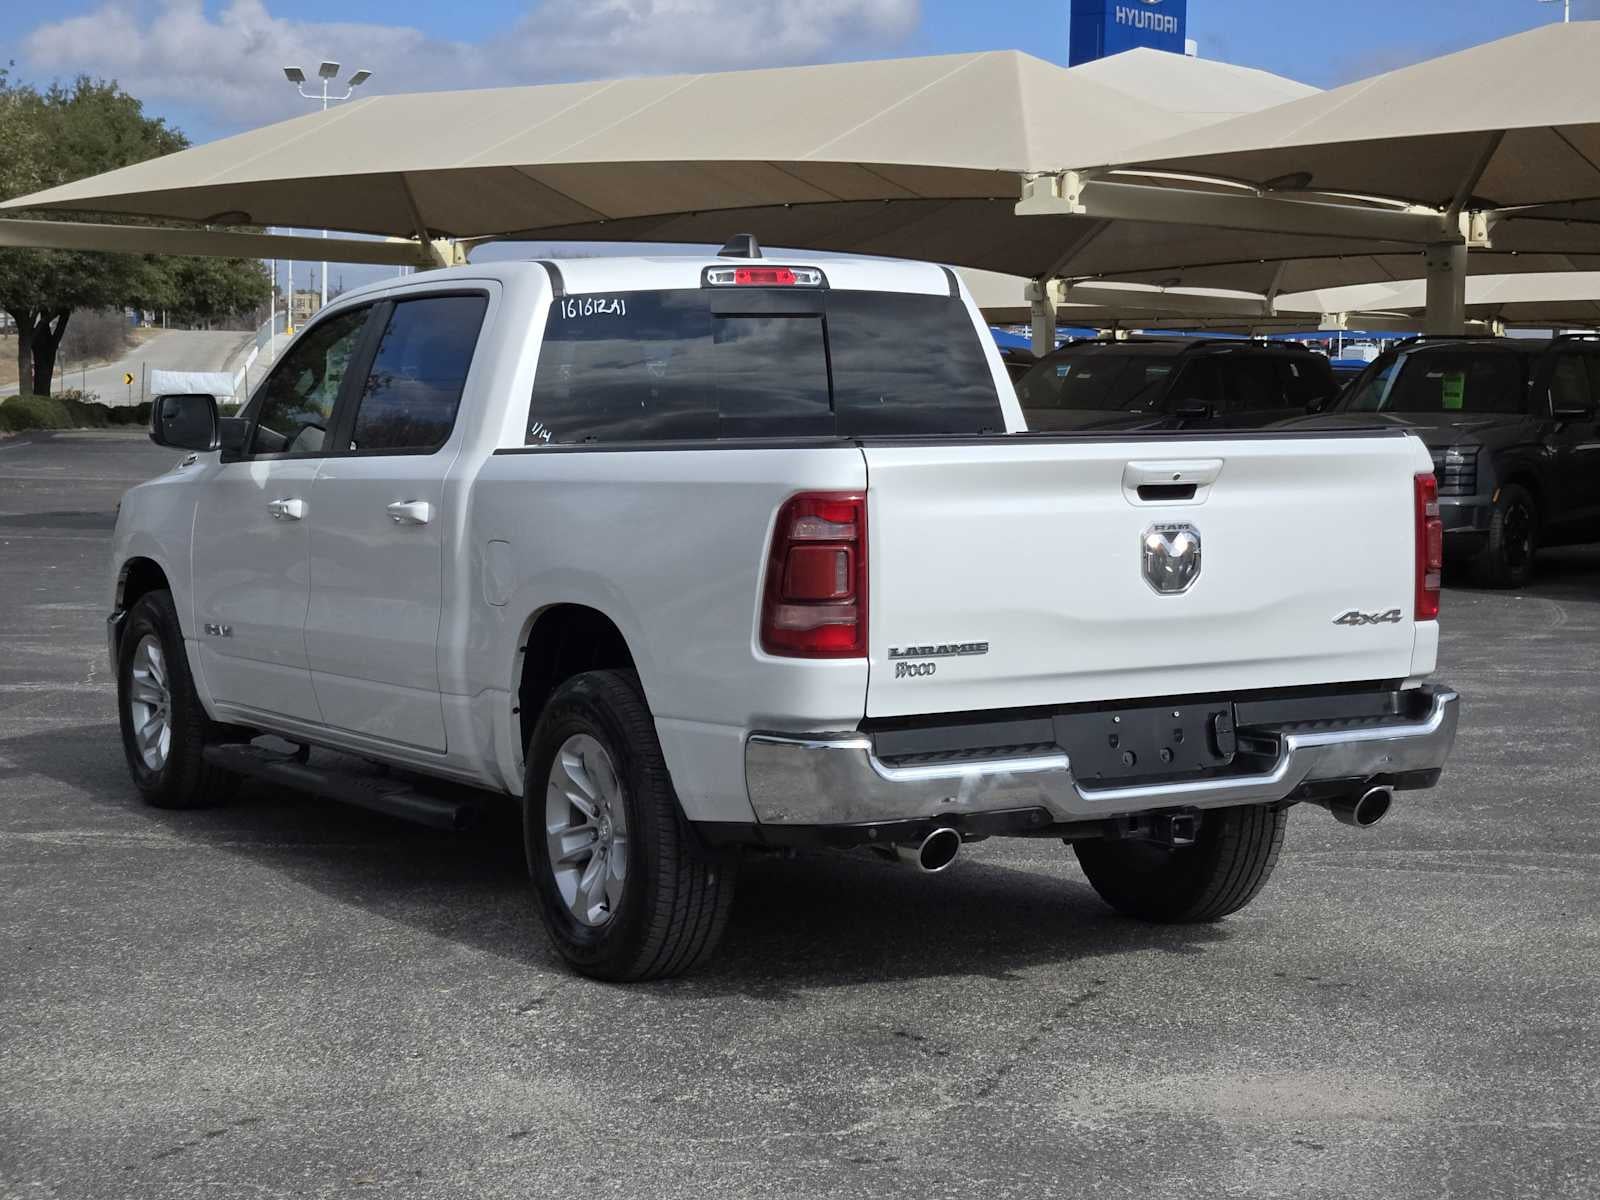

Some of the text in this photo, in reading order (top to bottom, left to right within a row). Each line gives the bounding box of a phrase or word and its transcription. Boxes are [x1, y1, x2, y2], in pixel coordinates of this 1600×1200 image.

[1116, 5, 1178, 34] HYUNDAI
[888, 641, 989, 660] LARAMIE
[895, 661, 936, 679] WOOD
